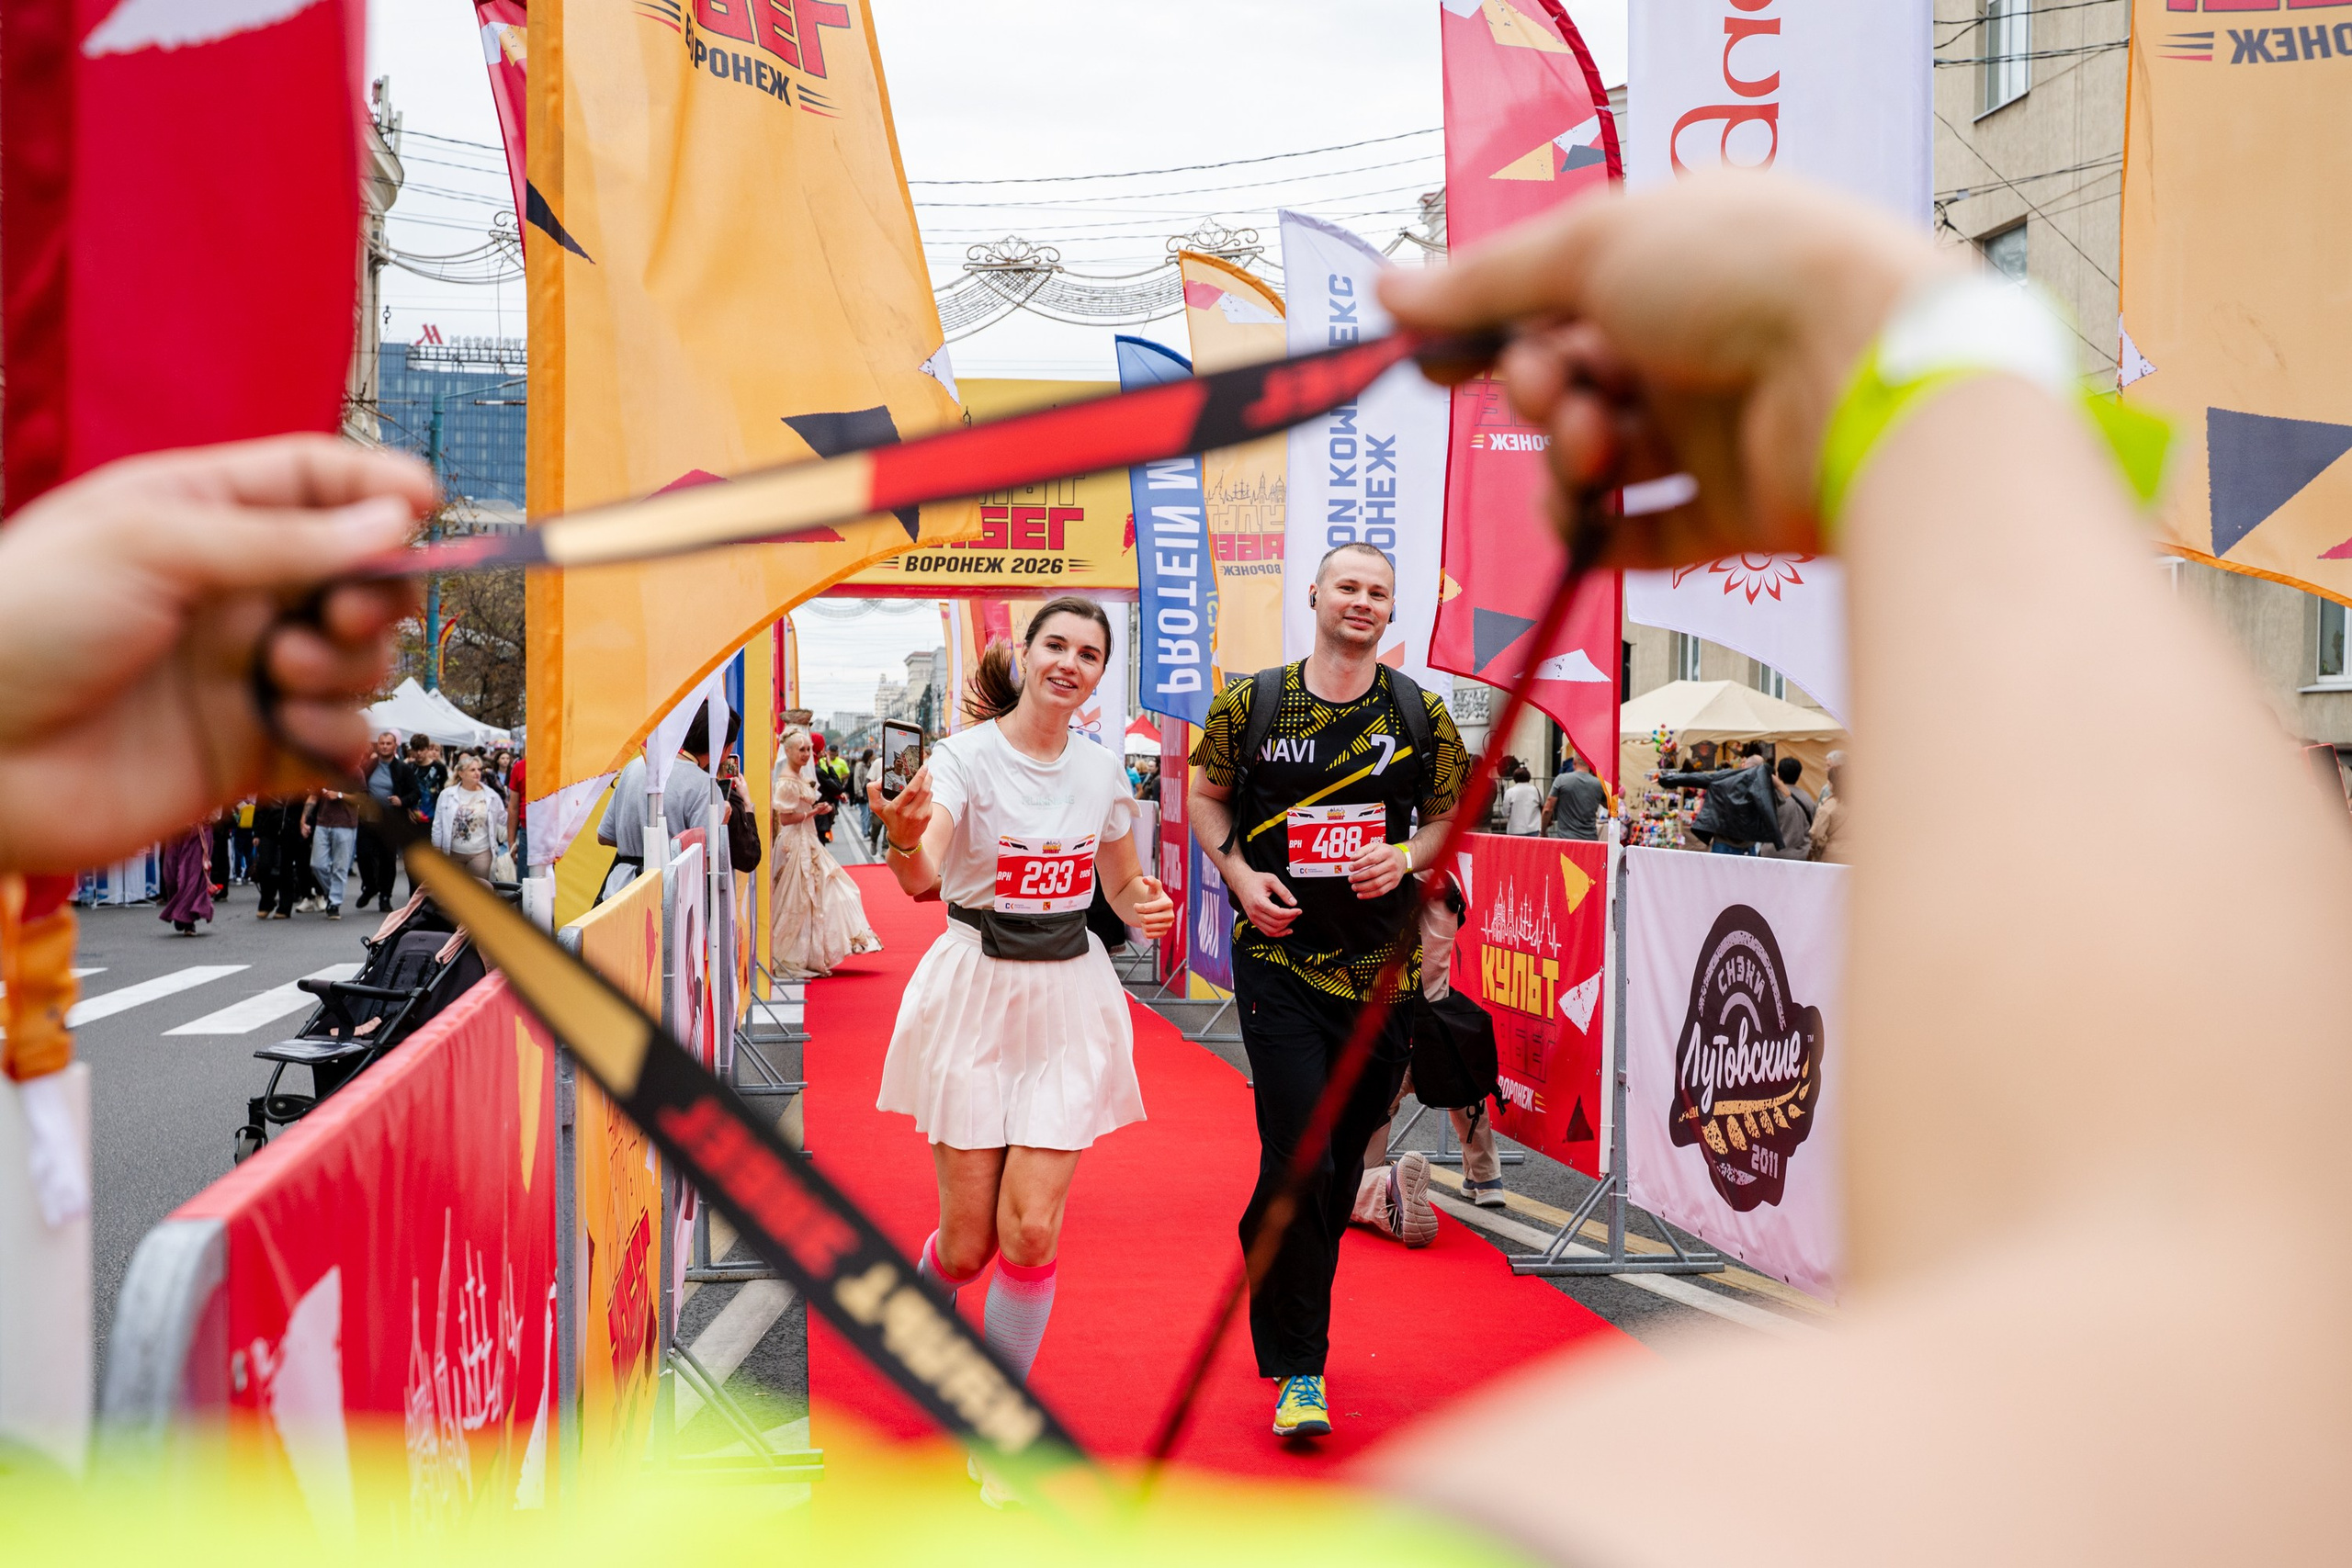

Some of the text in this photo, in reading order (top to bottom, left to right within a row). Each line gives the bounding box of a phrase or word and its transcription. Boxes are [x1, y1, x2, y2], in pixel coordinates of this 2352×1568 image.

[449, 334, 527, 351] MARRIOT
[928, 506, 1084, 550] БЕГ
[905, 555, 1064, 575] ВОРОНЕЖ 2026
[1370, 733, 1396, 776] 7
[1311, 825, 1363, 860] 488
[1019, 859, 1075, 896] 233
[1481, 942, 1560, 1021] КУЛЬТ
[1751, 1143, 1779, 1179] 2011
